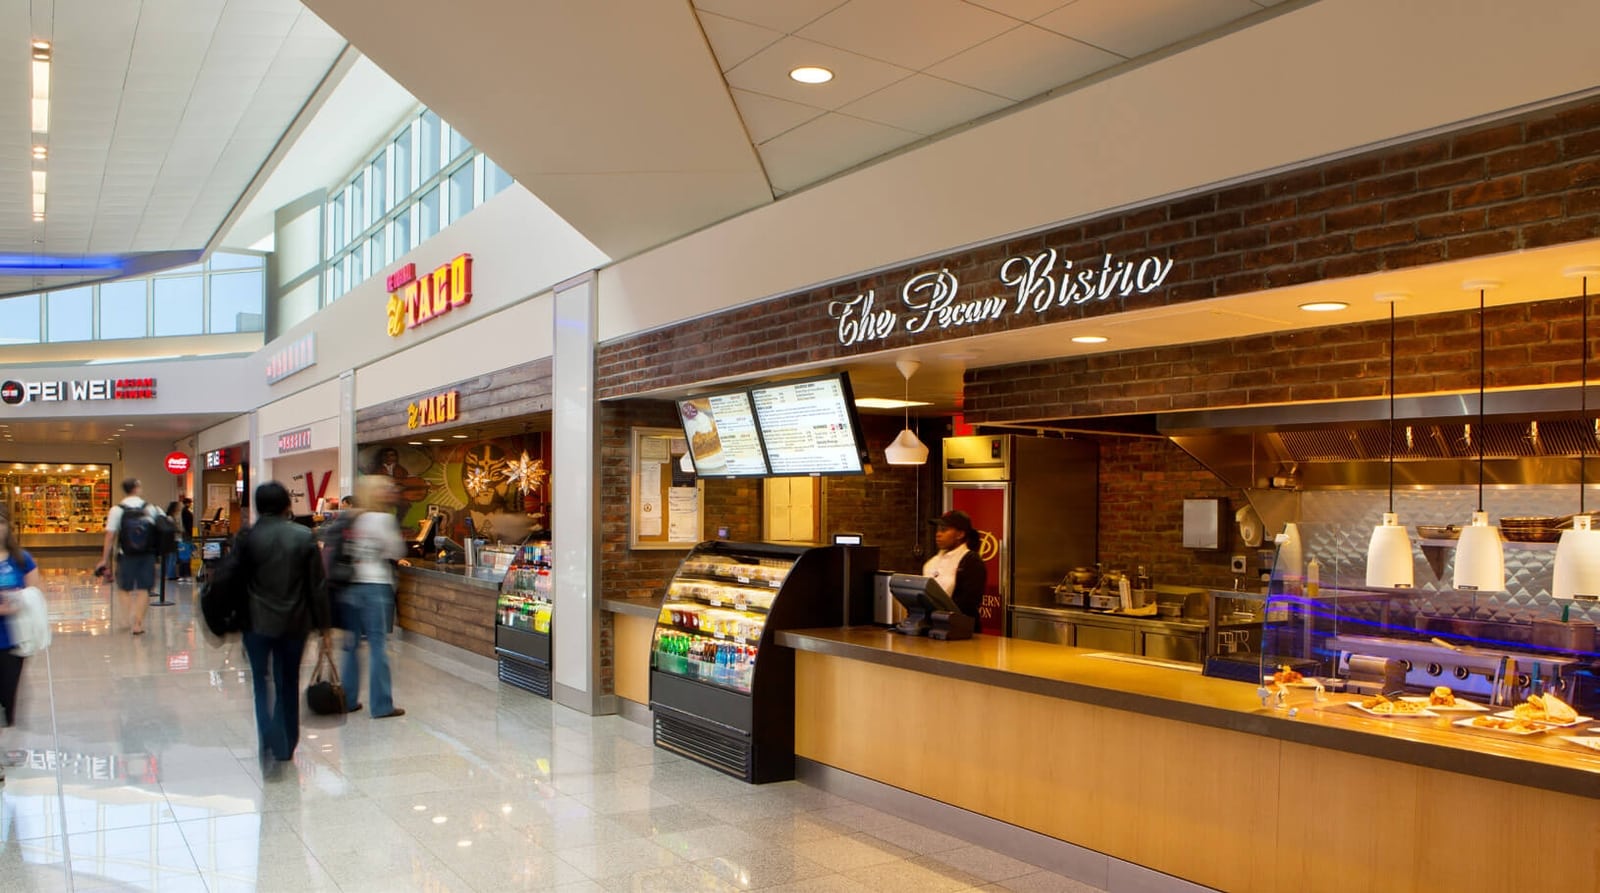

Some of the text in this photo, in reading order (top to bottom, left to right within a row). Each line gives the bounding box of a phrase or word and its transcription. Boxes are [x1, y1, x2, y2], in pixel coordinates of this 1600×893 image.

[405, 253, 472, 329] TACO
[828, 248, 1173, 346] The Pecan Bistro
[26, 379, 112, 401] PEI WEI
[418, 390, 459, 427] TACO
[982, 594, 1000, 608] ERN
